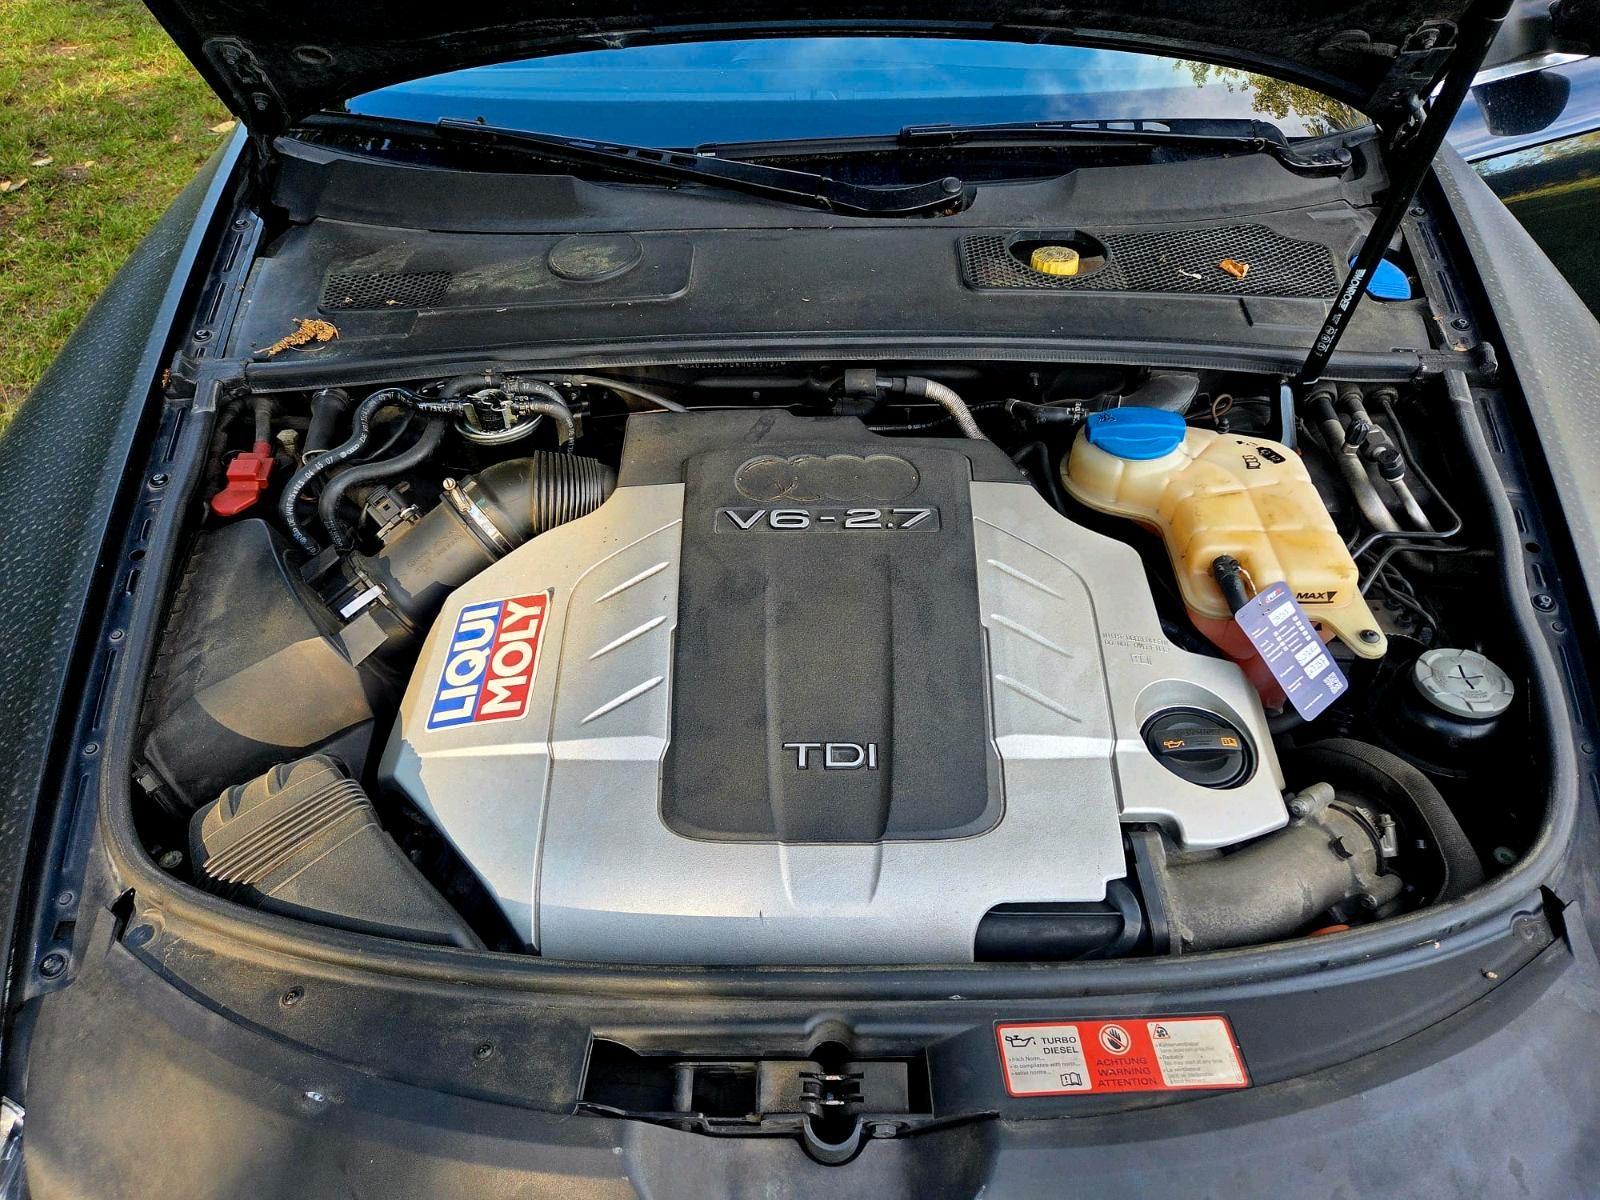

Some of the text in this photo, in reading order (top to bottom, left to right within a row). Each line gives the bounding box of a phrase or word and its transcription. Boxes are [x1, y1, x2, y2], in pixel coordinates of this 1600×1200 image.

[1296, 592, 1325, 600] MAX
[480, 600, 542, 715] MOLY
[432, 606, 500, 723] LIQUI
[783, 742, 878, 770] TDI
[1041, 1036, 1077, 1045] TURBO
[1043, 1046, 1079, 1055] DIESEL
[1096, 1057, 1148, 1067] ACHTUNG
[1098, 1067, 1152, 1077] WARNING
[1098, 1077, 1158, 1088] ATTENTION
